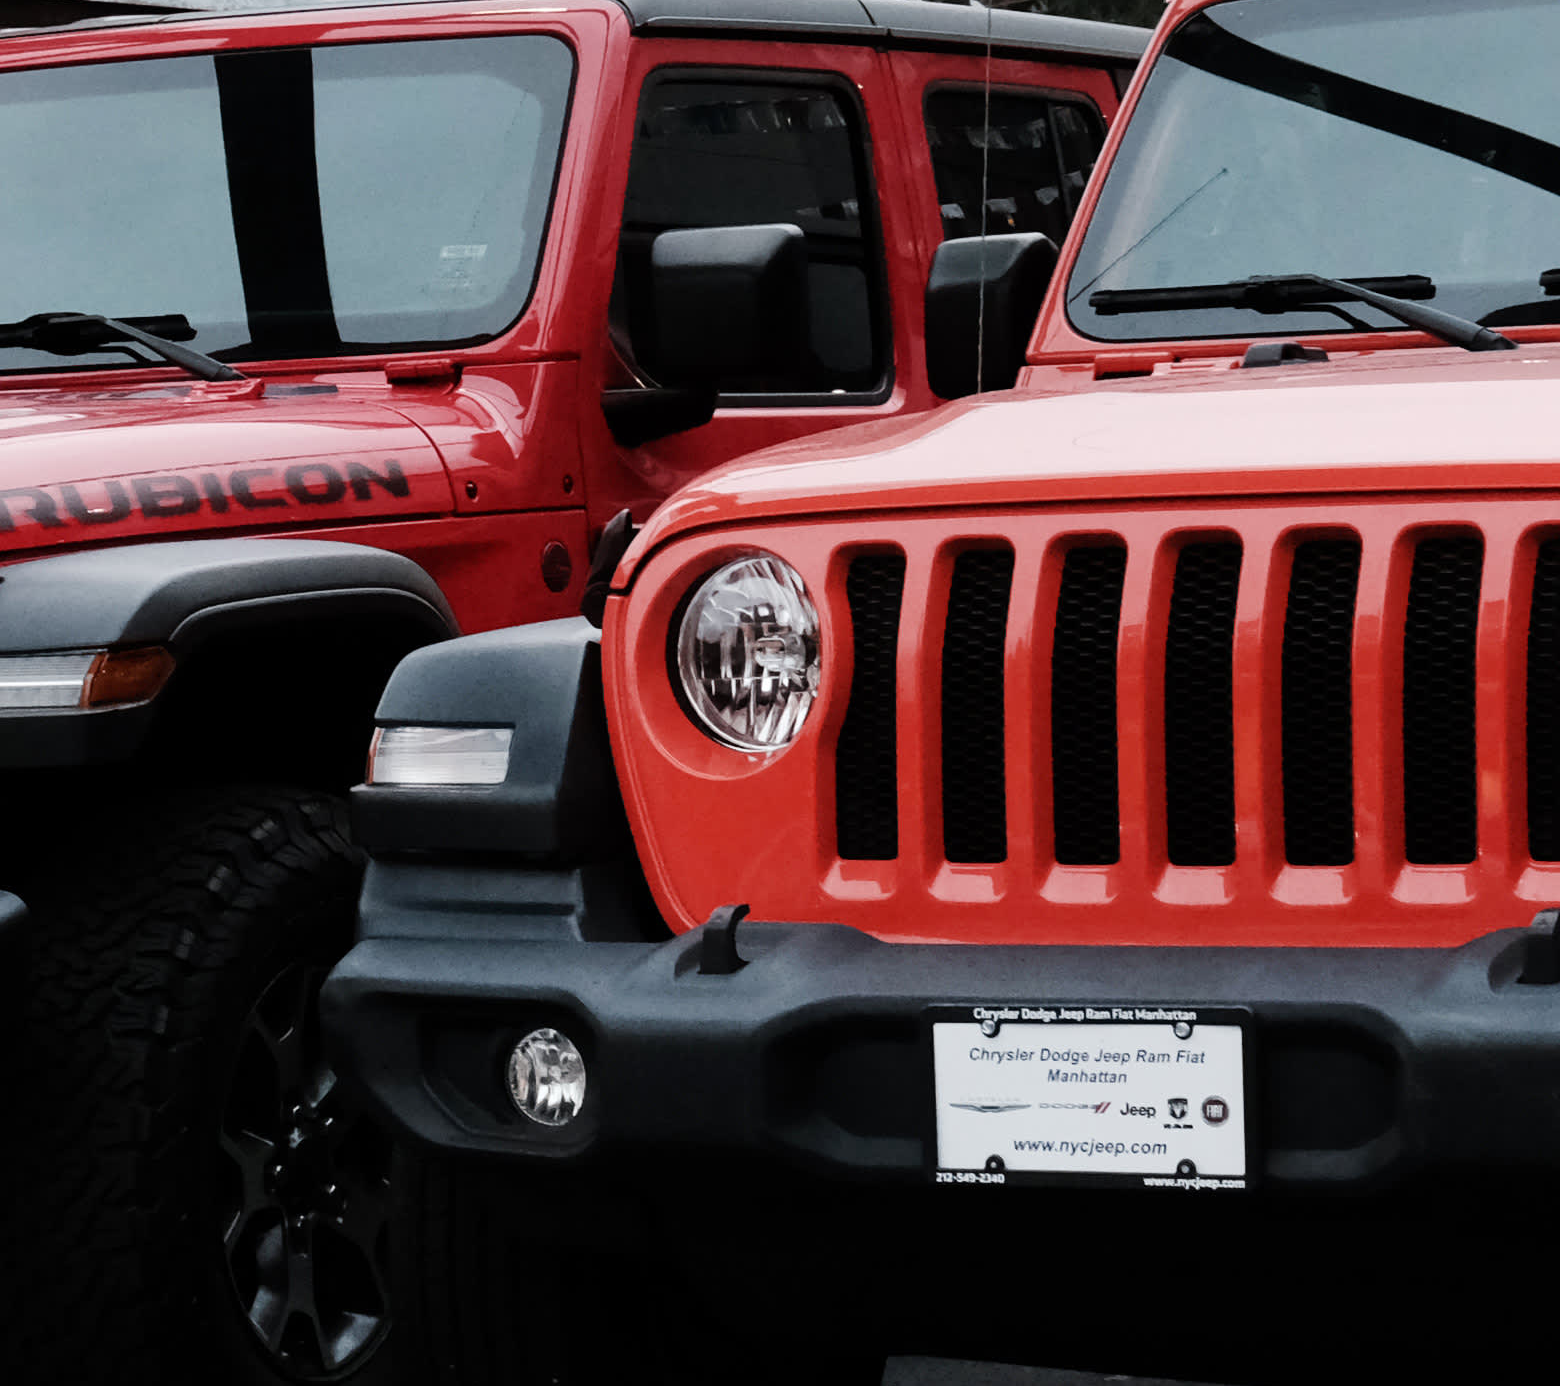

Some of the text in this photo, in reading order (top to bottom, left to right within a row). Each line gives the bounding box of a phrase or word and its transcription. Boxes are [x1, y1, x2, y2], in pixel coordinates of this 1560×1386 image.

[972, 1007, 1020, 1022] Chrysler
[1021, 1007, 1057, 1023] Dodge
[1059, 1008, 1085, 1023] Jeep
[969, 1047, 1206, 1065] Chrysler Dodge Jeep Ram Fiat
[1047, 1069, 1128, 1083] Manhattan
[1119, 1102, 1157, 1118] Jeep
[1013, 1137, 1168, 1157] www.nycjeep.com
